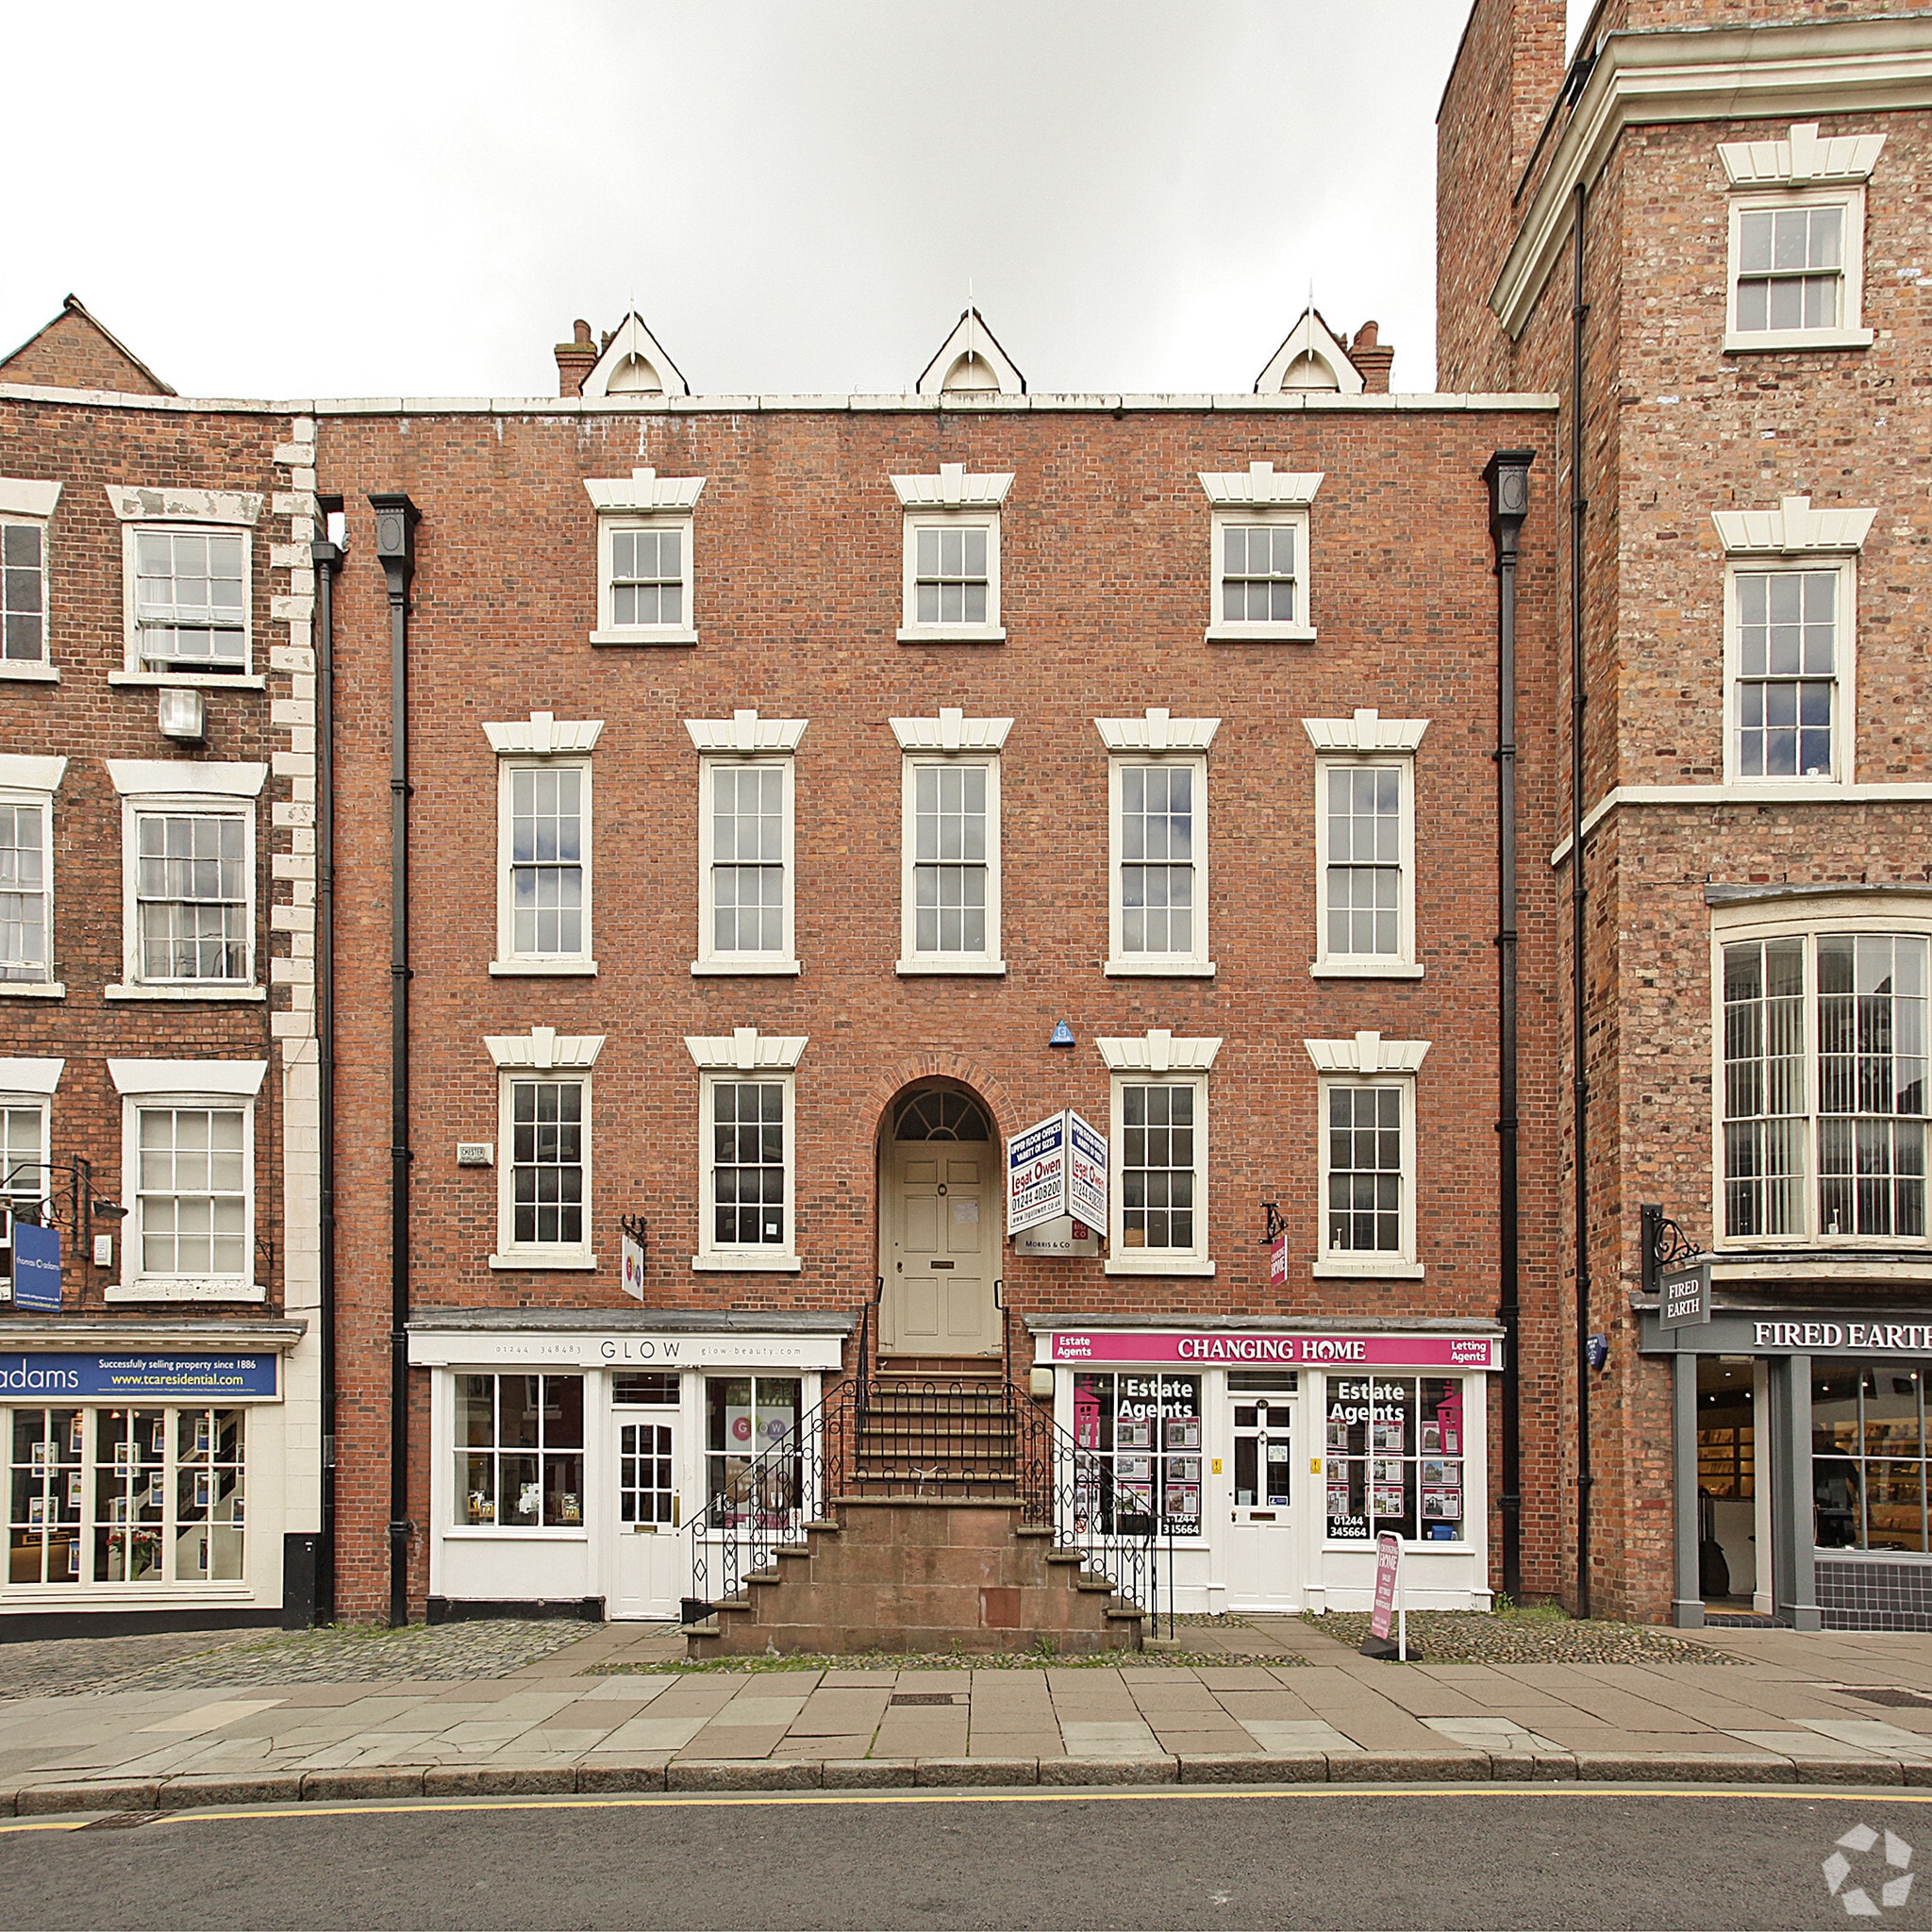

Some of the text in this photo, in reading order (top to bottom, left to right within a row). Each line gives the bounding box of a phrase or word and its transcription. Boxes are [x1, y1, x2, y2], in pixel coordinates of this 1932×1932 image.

[1011, 1169, 1033, 1196] Legat
[1034, 1158, 1061, 1180] Owen
[1012, 1191, 1033, 1211] 01244
[1034, 1179, 1062, 1200] 408200
[1668, 1279, 1699, 1300] FIRED
[1667, 1297, 1700, 1318] EARTH
[1059, 1336, 1091, 1346] Estate
[1753, 1322, 1843, 1347] FIRED
[495, 1345, 528, 1354] 01244
[540, 1344, 581, 1354] 348483
[600, 1341, 680, 1359] GLOW
[1057, 1346, 1091, 1358] Agents
[1177, 1339, 1367, 1360] CHANGING HOME
[1451, 1341, 1487, 1353] Letting
[98, 1358, 257, 1371] Successfully selling property since 1886
[1451, 1351, 1486, 1363] Agents
[111, 1374, 244, 1386] www.tcaresidential.com
[1126, 1379, 1193, 1397] Estate
[1338, 1382, 1405, 1400] Estate
[1119, 1400, 1193, 1422] Agents
[1330, 1403, 1405, 1425] Agents
[738, 1422, 783, 1433] GOW
[1334, 1515, 1364, 1526] 01244
[1330, 1526, 1367, 1538] 345664
[1378, 1552, 1398, 1571] HOME
